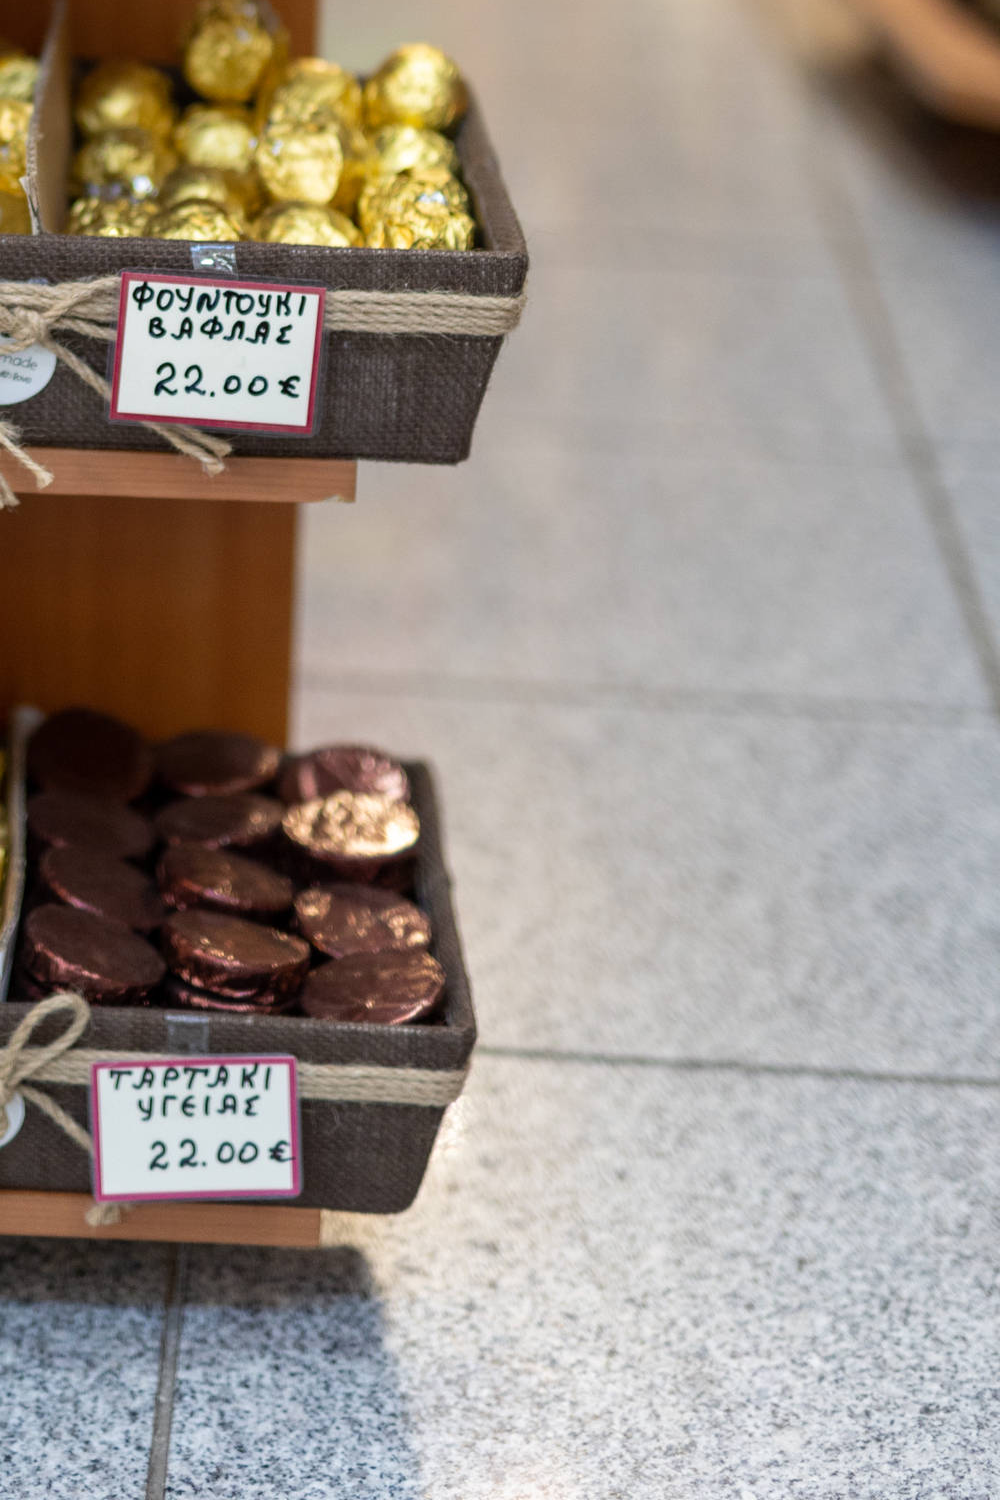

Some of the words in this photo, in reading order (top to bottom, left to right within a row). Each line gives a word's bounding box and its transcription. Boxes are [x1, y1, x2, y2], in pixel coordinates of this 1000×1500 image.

[132, 281, 307, 318] ΦΟΥΝΤΟΥΚΙ
[148, 315, 293, 345] ΒΑΦΛΑΣ
[154, 362, 301, 398] 22.00€
[109, 1063, 272, 1091] ΤΑΡΤΑΚΙ
[137, 1094, 261, 1122] ΥΓΕΙΑΣ
[149, 1138, 296, 1171] 22.00€
